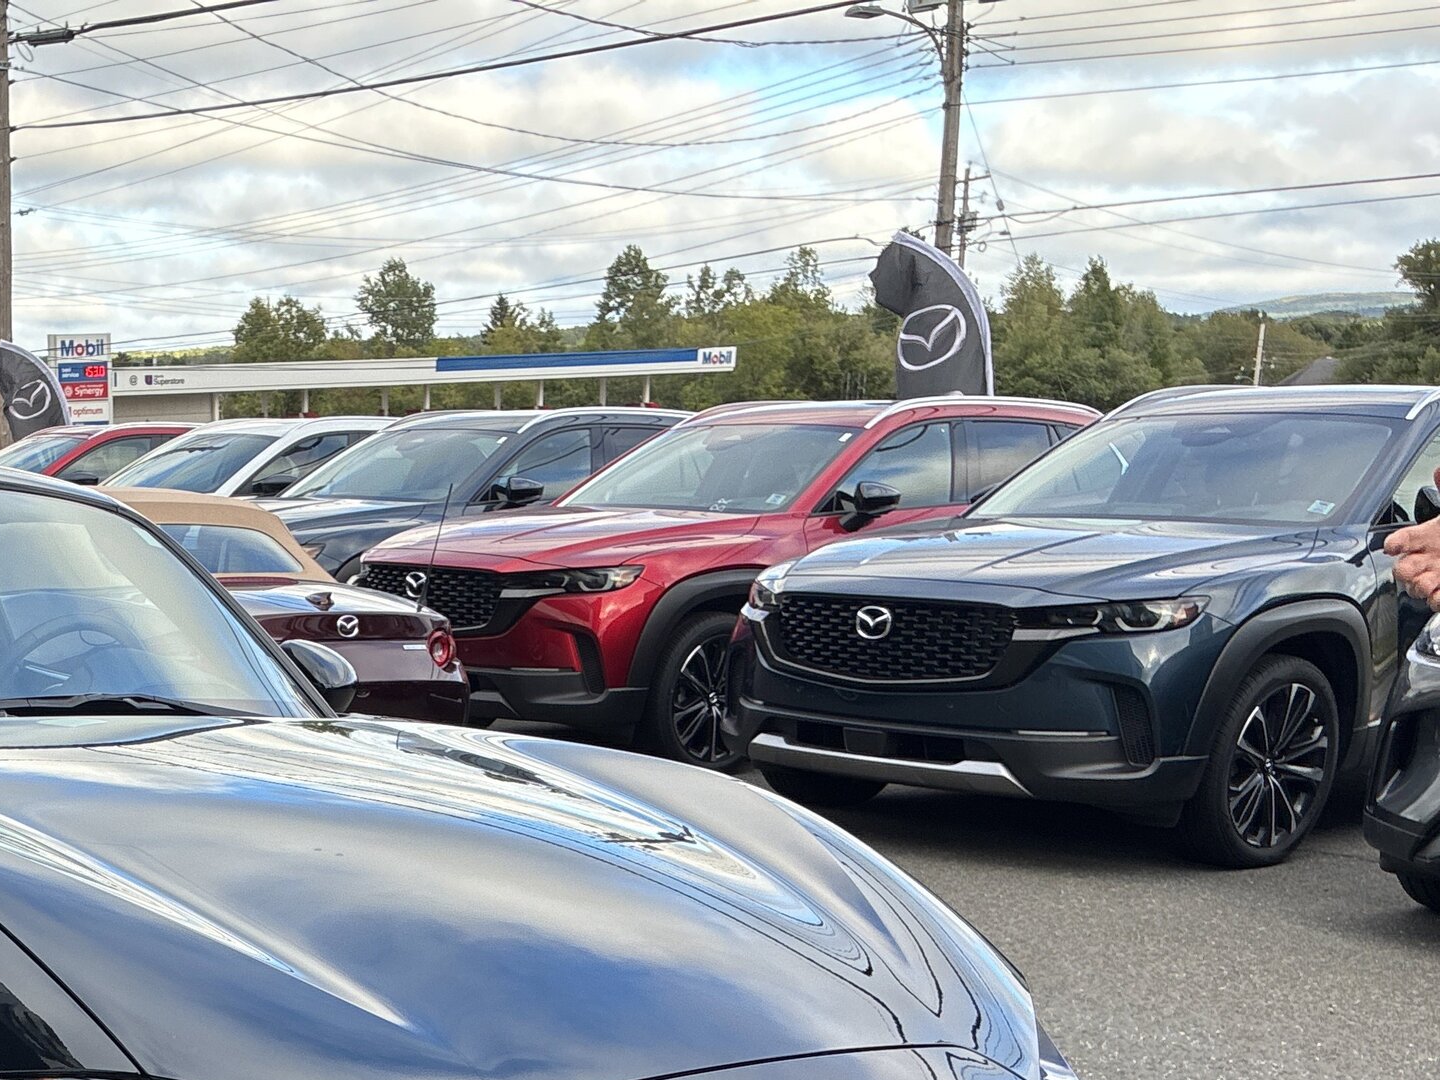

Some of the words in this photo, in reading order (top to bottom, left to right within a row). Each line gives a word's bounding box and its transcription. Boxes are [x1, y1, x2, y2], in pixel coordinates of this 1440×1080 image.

[60, 339, 104, 357] Mobil
[702, 350, 733, 365] Mobil
[153, 377, 185, 387] Superstore
[74, 386, 104, 397] Synergy
[72, 406, 103, 417] optimum
